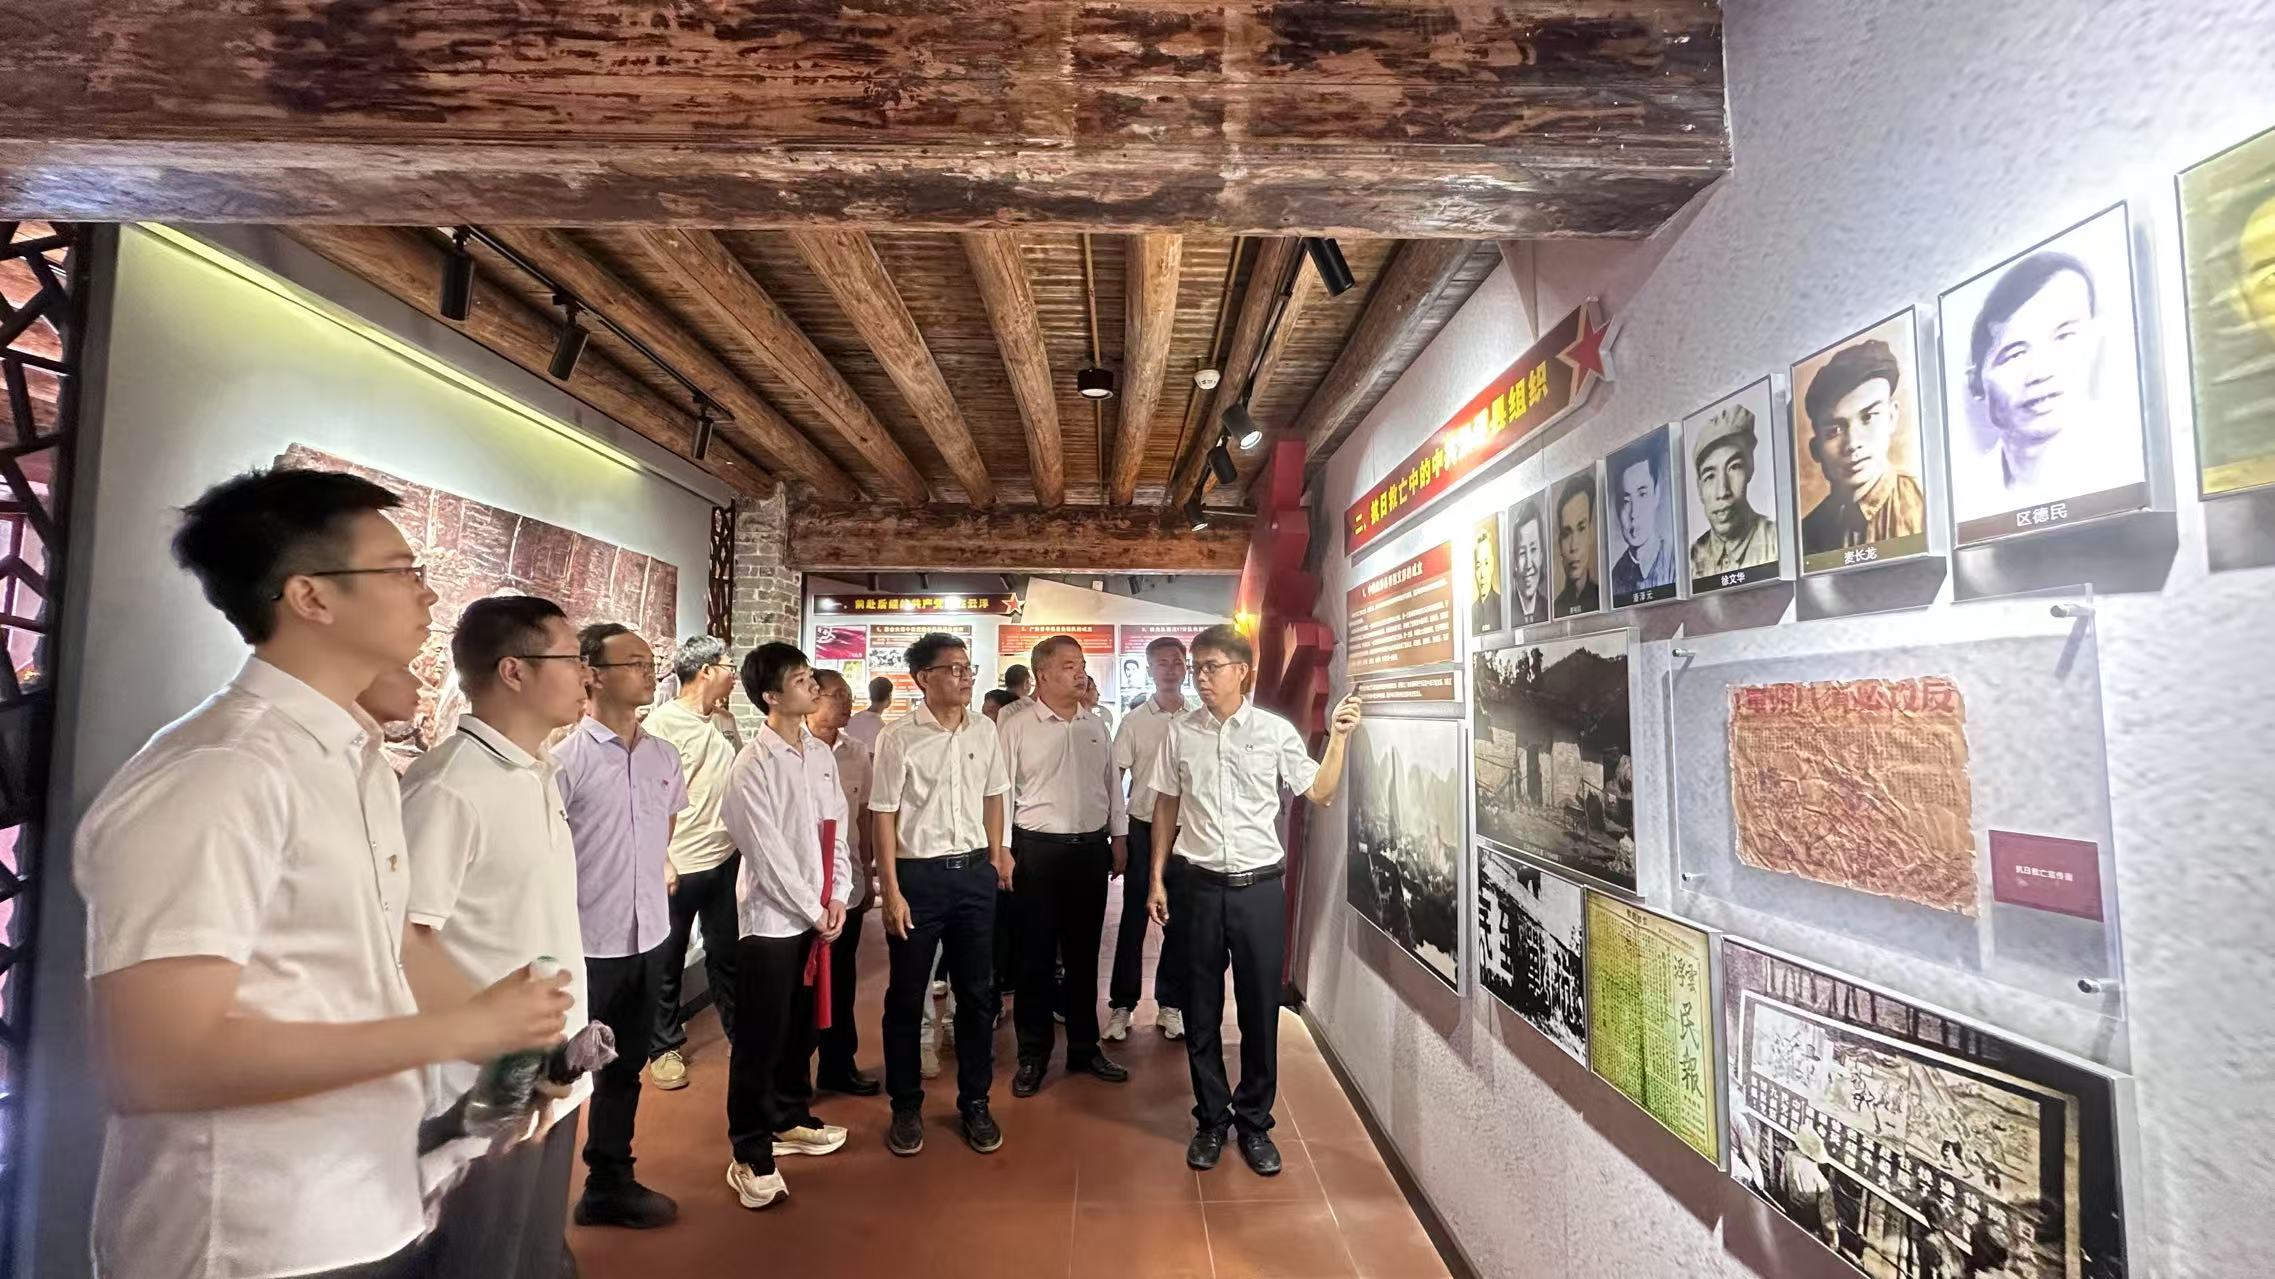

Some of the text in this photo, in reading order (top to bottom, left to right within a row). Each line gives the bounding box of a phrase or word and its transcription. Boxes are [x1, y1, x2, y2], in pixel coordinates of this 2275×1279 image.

[1354, 361, 1548, 535] 二、抗日救亡中的中共县组织
[2016, 502, 2068, 527] 区德民
[1721, 572, 1745, 586] 徐文华
[831, 598, 989, 610] 一、前赴后继的共产党云浮
